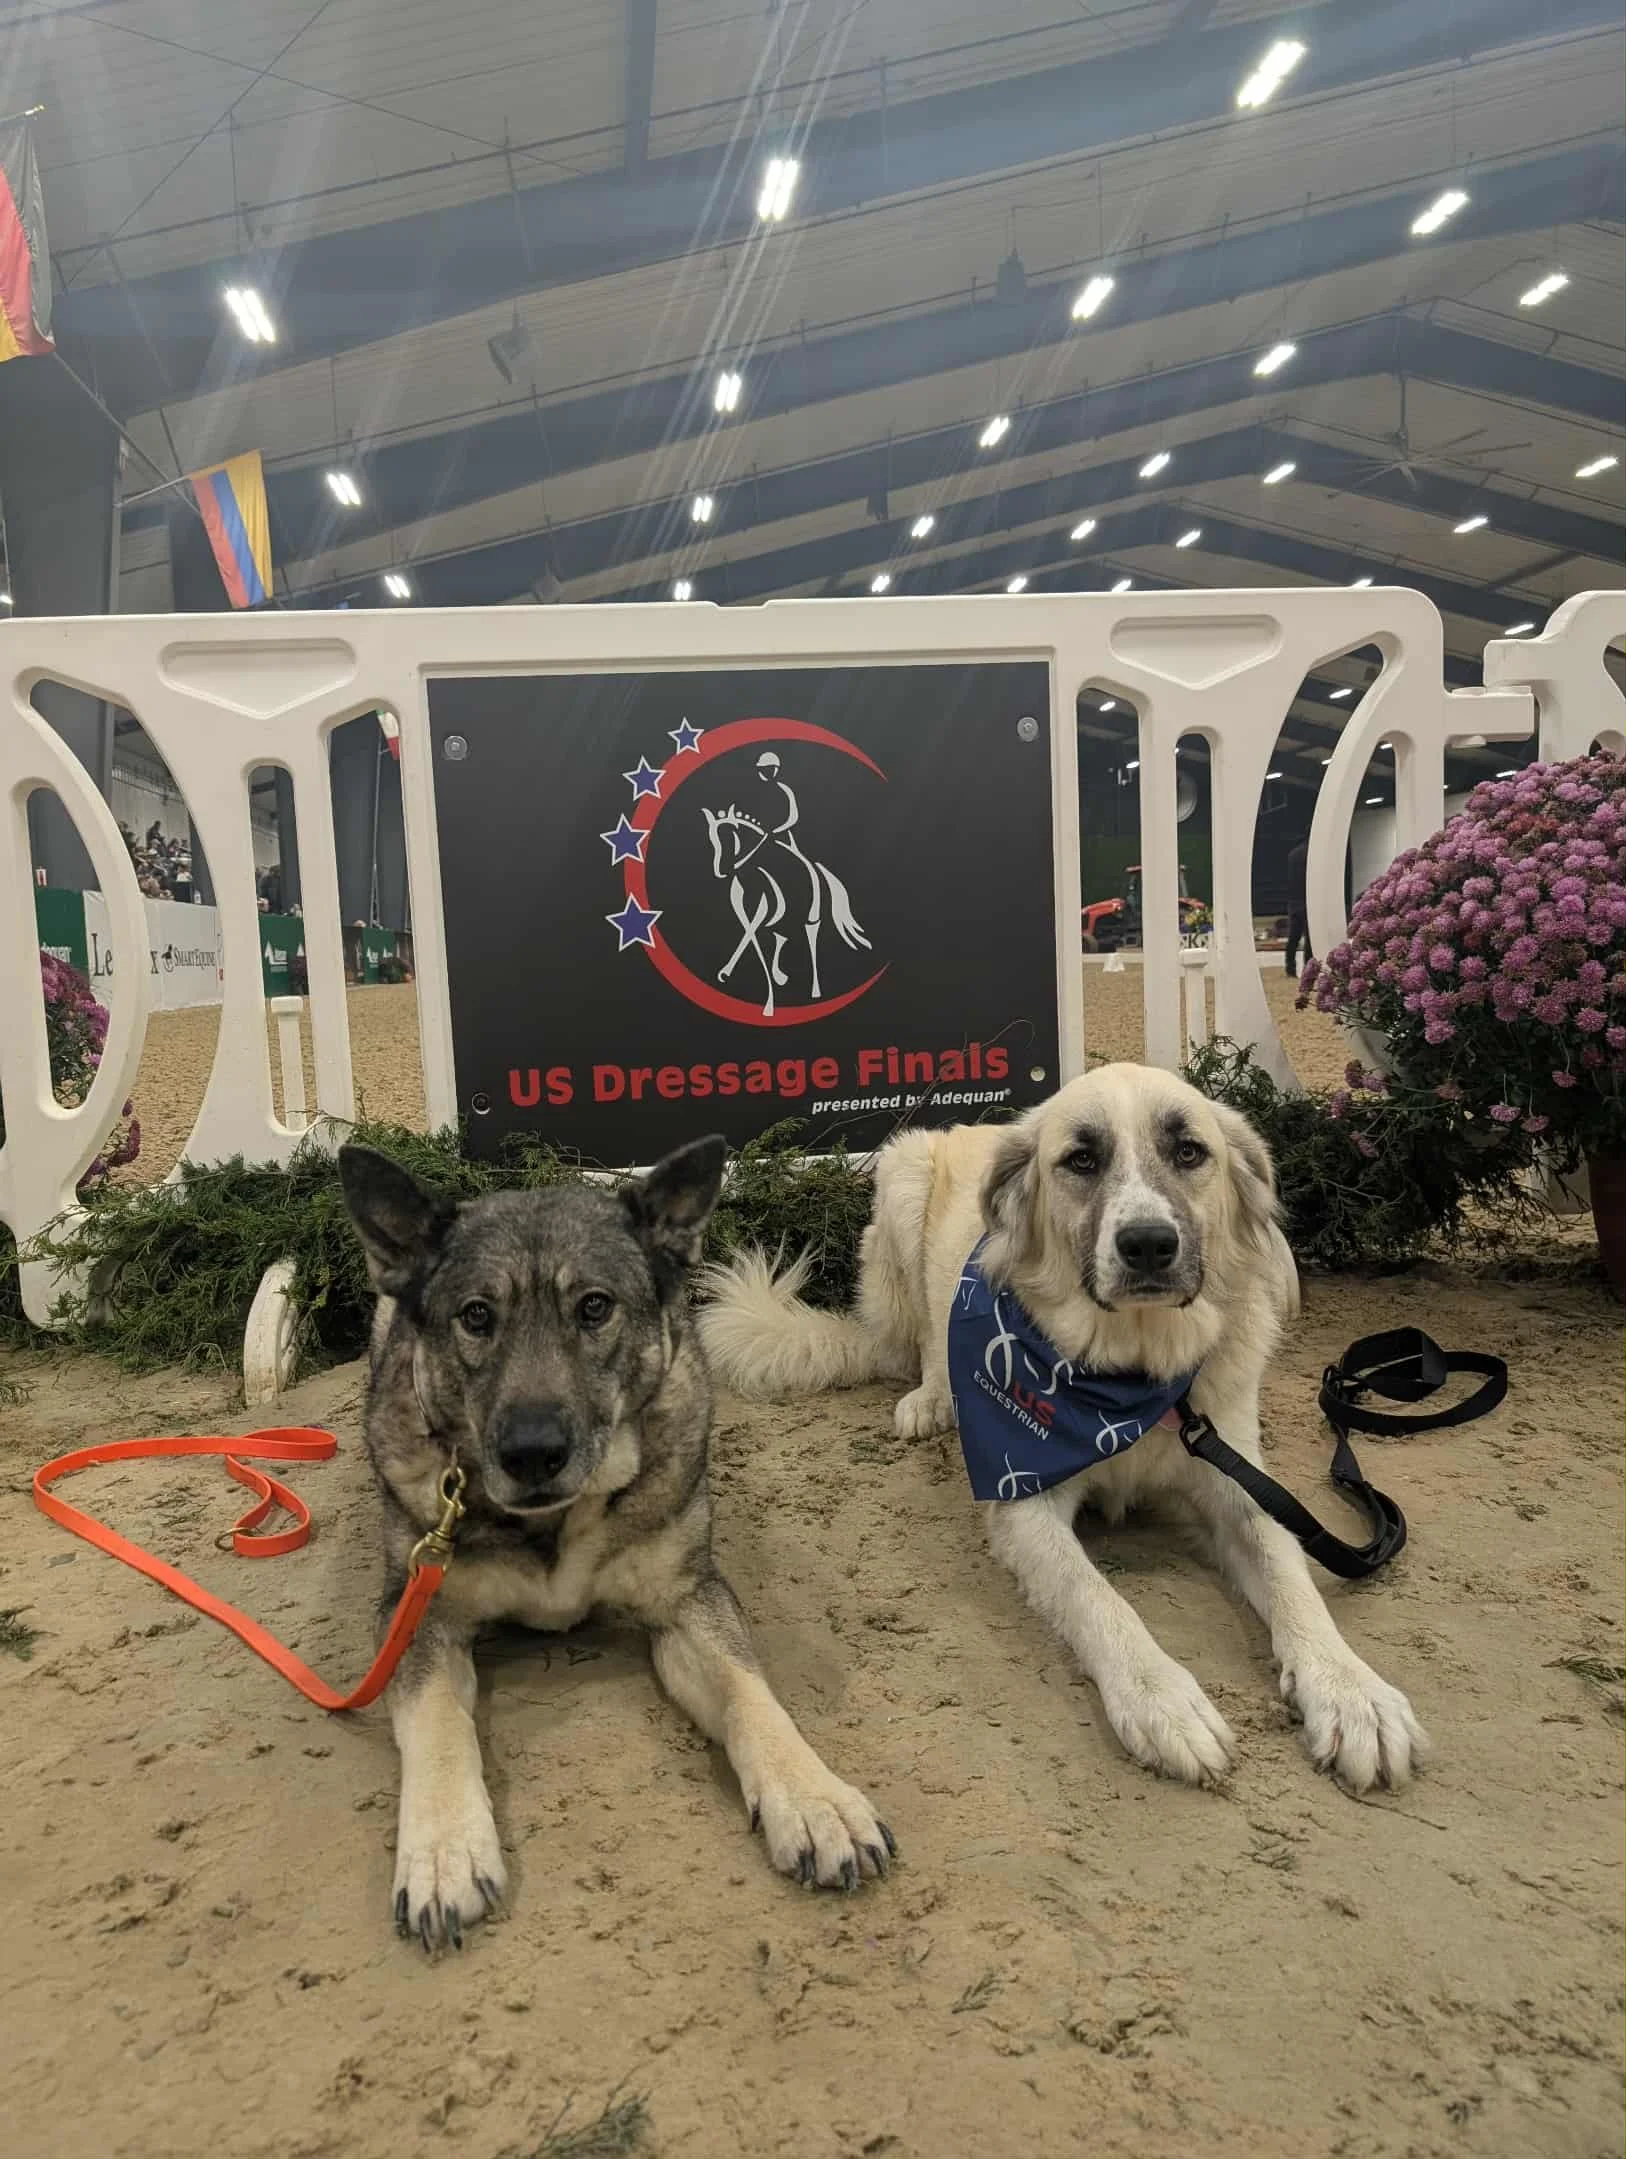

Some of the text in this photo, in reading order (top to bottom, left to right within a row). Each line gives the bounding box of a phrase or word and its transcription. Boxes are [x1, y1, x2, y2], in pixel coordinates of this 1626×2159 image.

[509, 1043, 1010, 1106] US Dressage Finals
[811, 1094, 901, 1115] presented
[972, 1369, 1050, 1441] EQUESTRIAN
[1013, 1381, 1057, 1426] US
